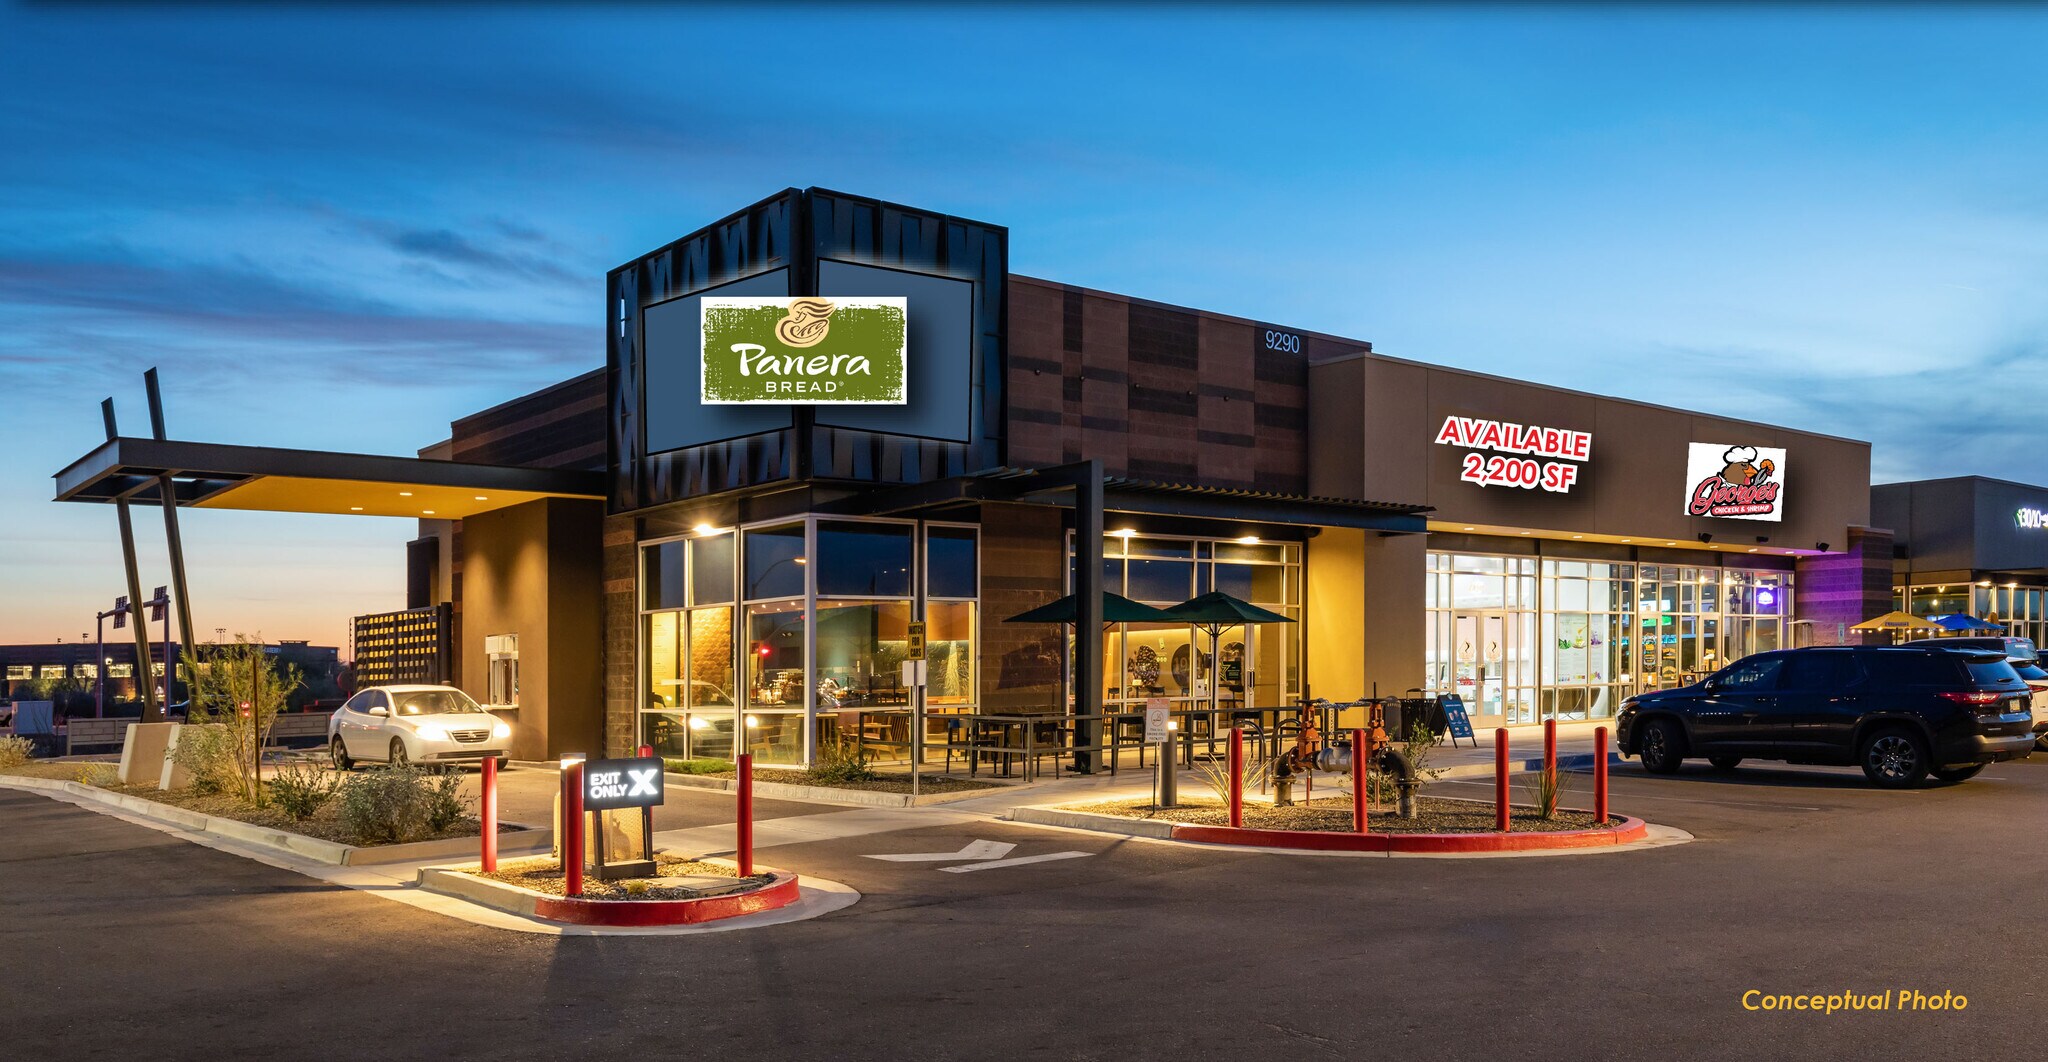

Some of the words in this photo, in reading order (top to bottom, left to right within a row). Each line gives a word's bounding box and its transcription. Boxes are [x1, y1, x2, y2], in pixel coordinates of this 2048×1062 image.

[1265, 330, 1300, 354] 9290
[730, 342, 872, 378] Panera
[1439, 418, 1589, 458] AVAILABLE
[1464, 455, 1538, 485] 2,200
[1544, 464, 1574, 489] SF
[1690, 476, 1780, 515] George's
[1714, 506, 1740, 515] CHICKEN
[1746, 504, 1770, 513] SHRIMP
[908, 625, 924, 635] WATCH
[911, 636, 921, 646] FOR
[910, 648, 922, 658] CARS
[590, 772, 621, 786] EXIT
[590, 784, 628, 799] ONLY
